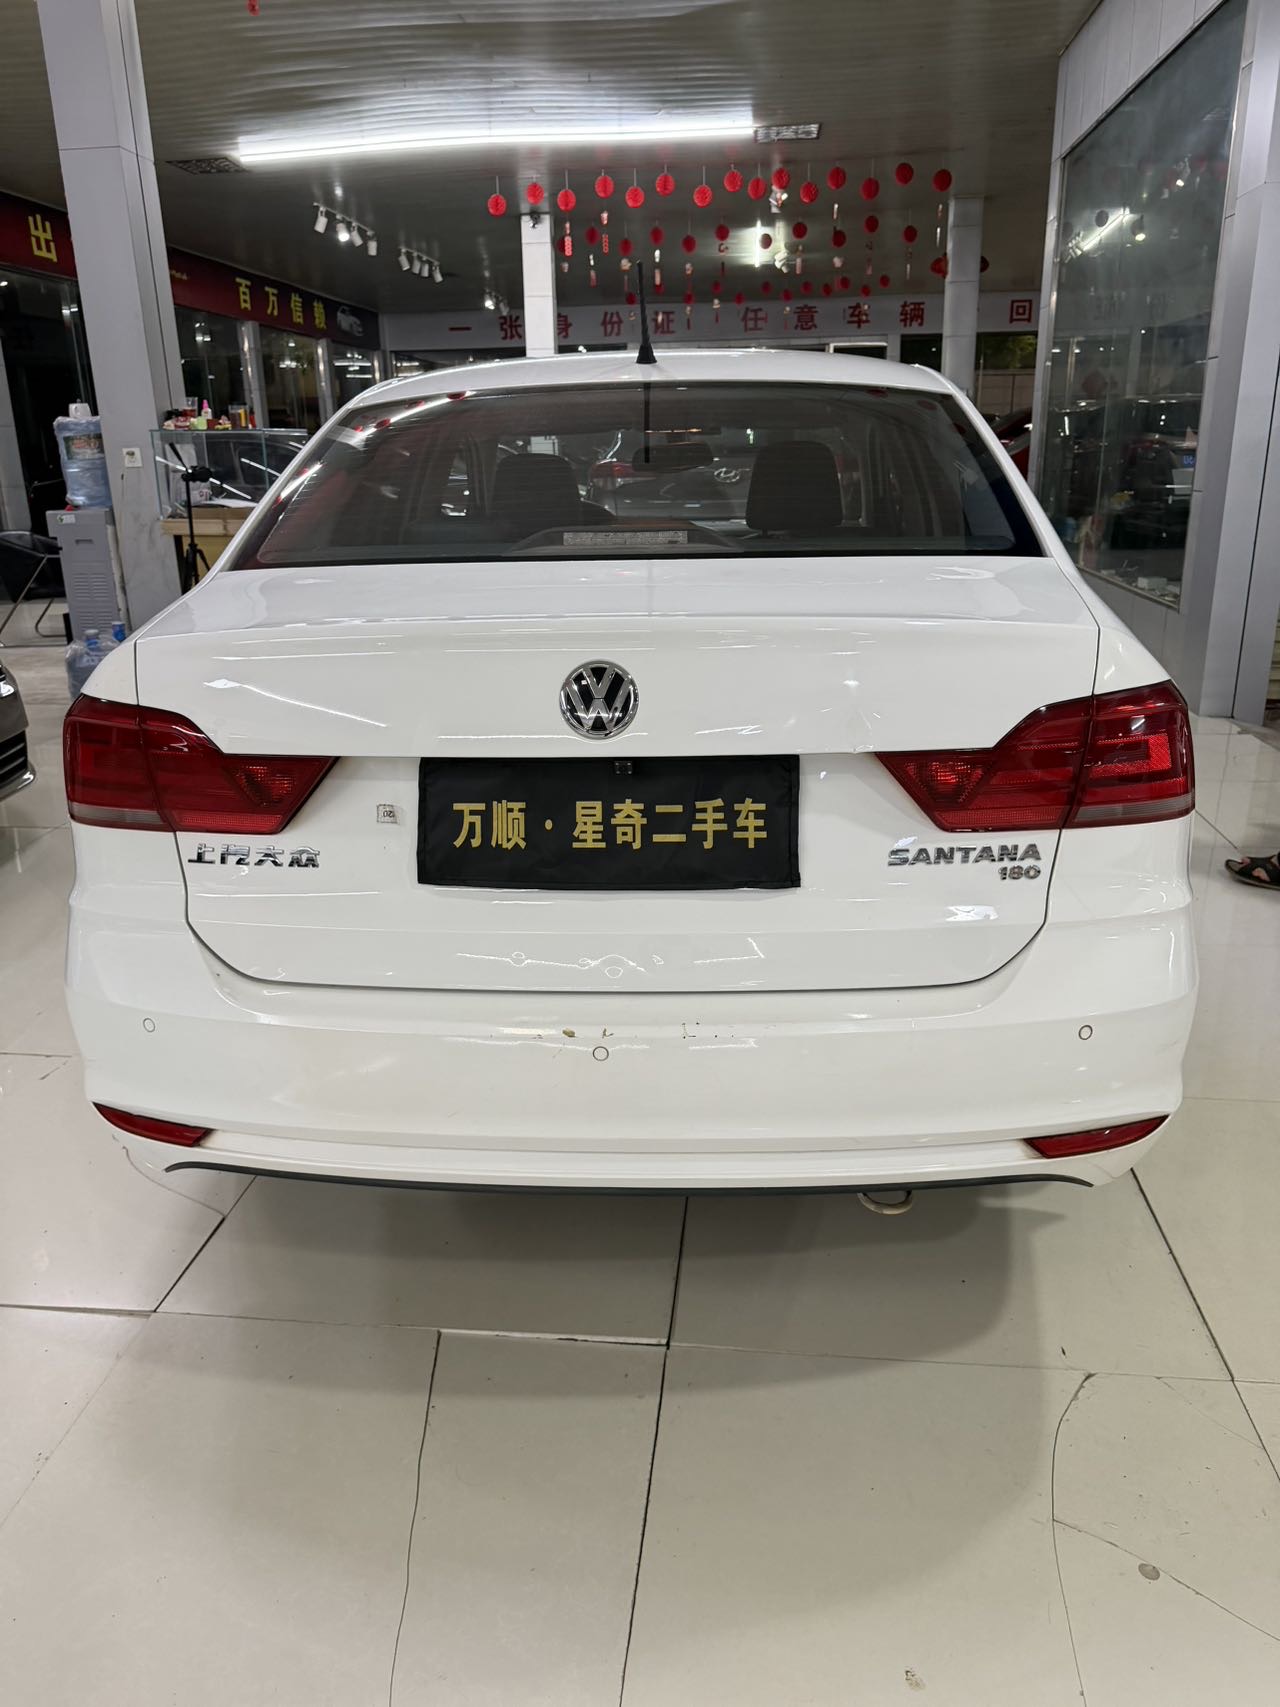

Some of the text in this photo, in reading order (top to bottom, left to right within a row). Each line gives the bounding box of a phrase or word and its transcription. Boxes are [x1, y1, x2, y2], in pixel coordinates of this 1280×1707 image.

[28, 213, 58, 263] 出
[888, 843, 1042, 866] SANTANA
[998, 864, 1042, 880] 180
